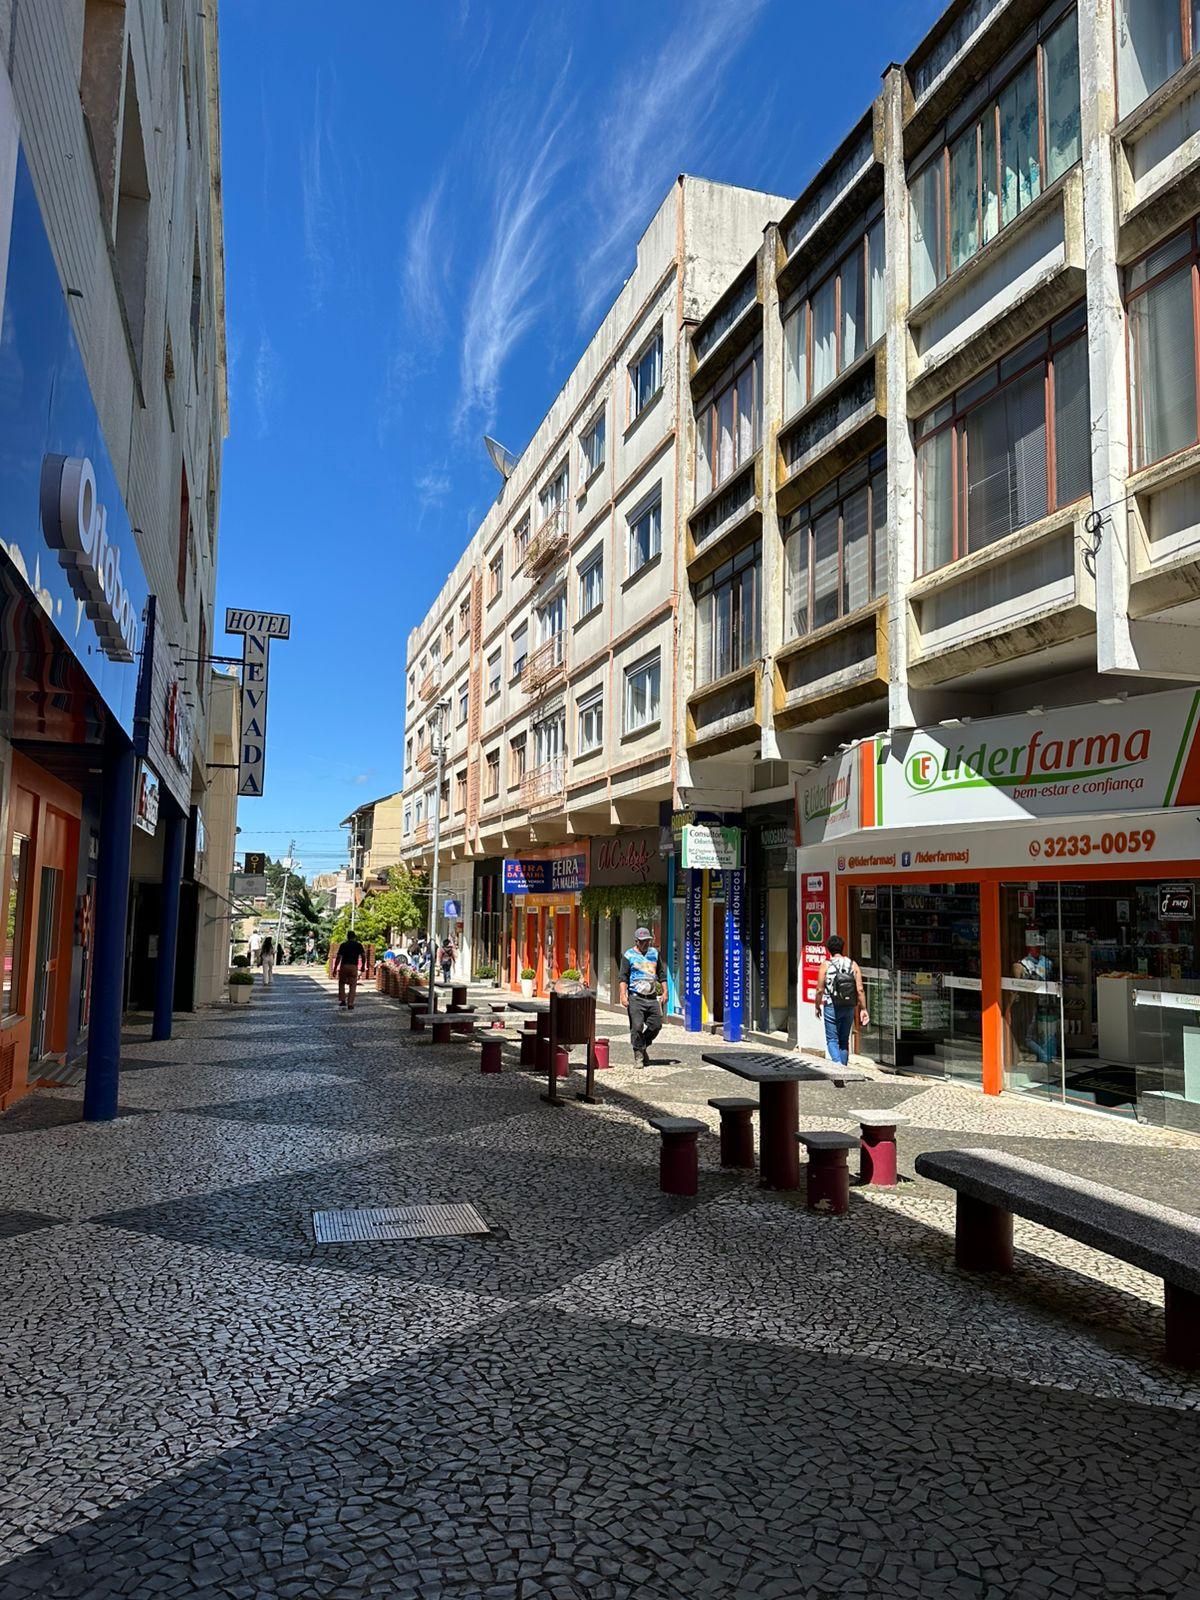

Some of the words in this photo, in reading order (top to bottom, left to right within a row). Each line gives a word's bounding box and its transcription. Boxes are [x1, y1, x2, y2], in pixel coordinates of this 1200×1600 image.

[229, 611, 288, 634] HOTEL
[241, 634, 266, 793] NEVADA
[942, 729, 1151, 785] líderfarma
[1013, 782, 1070, 799] bem-estar
[1073, 785, 1079, 794] e
[1082, 777, 1144, 796] confiança
[1044, 830, 1156, 857] 3233-0059
[507, 864, 544, 872] FEIRA
[552, 878, 560, 890] DA
[561, 876, 578, 889] MALHA
[553, 858, 578, 876] FEIRA
[693, 886, 701, 929] TÉCNICA
[731, 871, 740, 940] ELETRÔNICOS
[693, 930, 701, 996] ASSISTÊNCIA
[732, 949, 740, 1008] CELULARES
